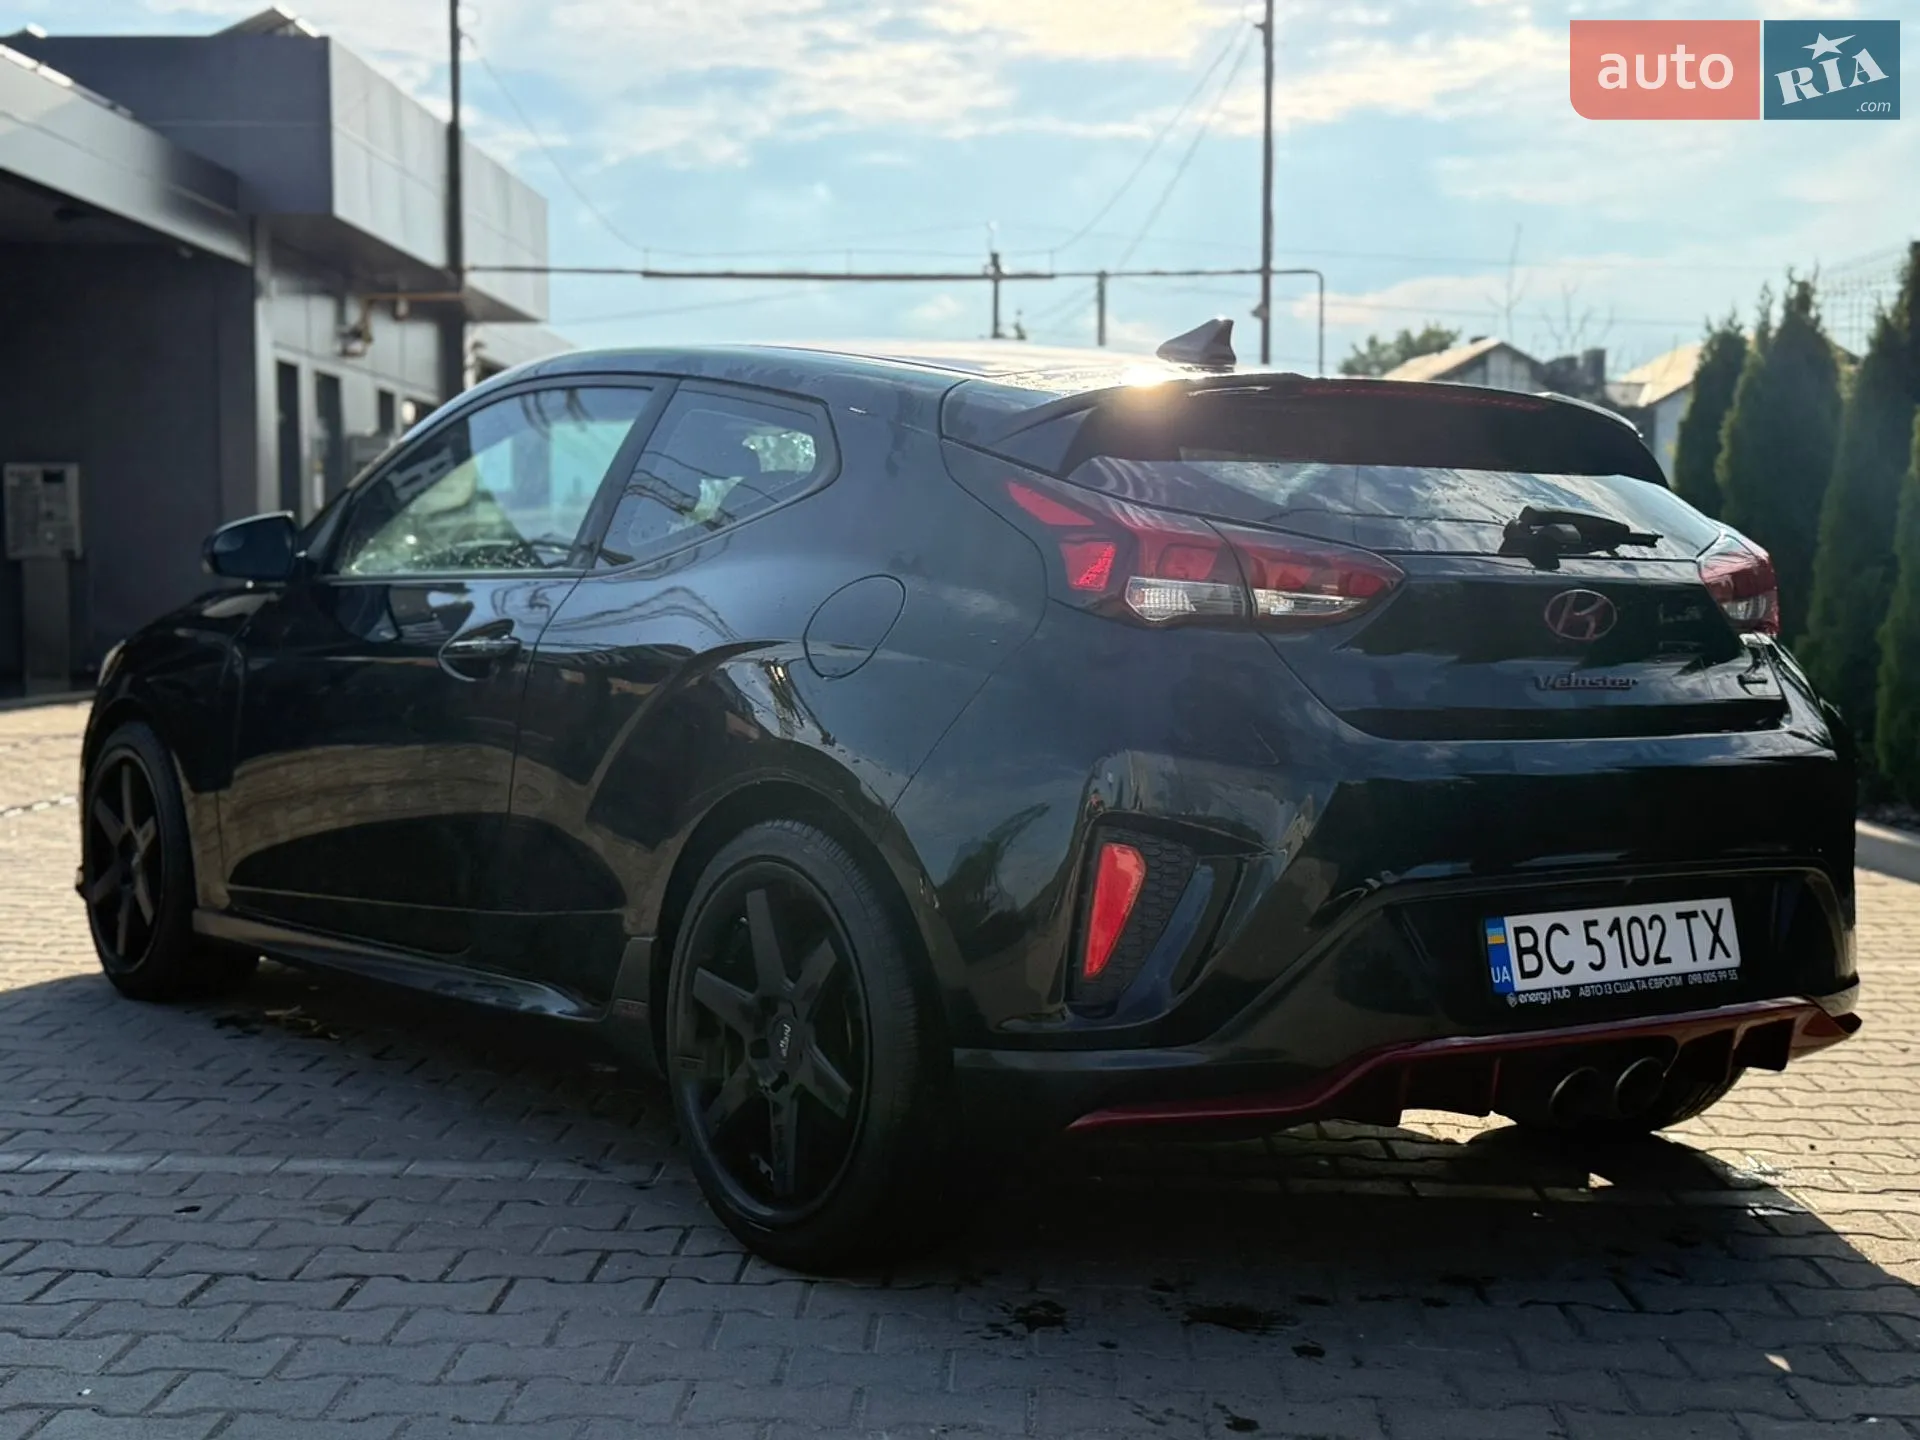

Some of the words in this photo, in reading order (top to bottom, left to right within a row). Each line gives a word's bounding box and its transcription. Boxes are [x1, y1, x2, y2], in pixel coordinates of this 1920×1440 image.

[1513, 923, 1574, 979] BC
[1583, 914, 1672, 971] 5102
[1676, 908, 1732, 962] TX
[1491, 965, 1511, 983] UA
[1518, 990, 1551, 1004] energy
[1552, 986, 1571, 1000] hub
[1579, 984, 1603, 997] АВТО
[1613, 981, 1636, 994] США
[1636, 979, 1648, 991] ТА
[1648, 975, 1683, 989] ЄВРОПИ
